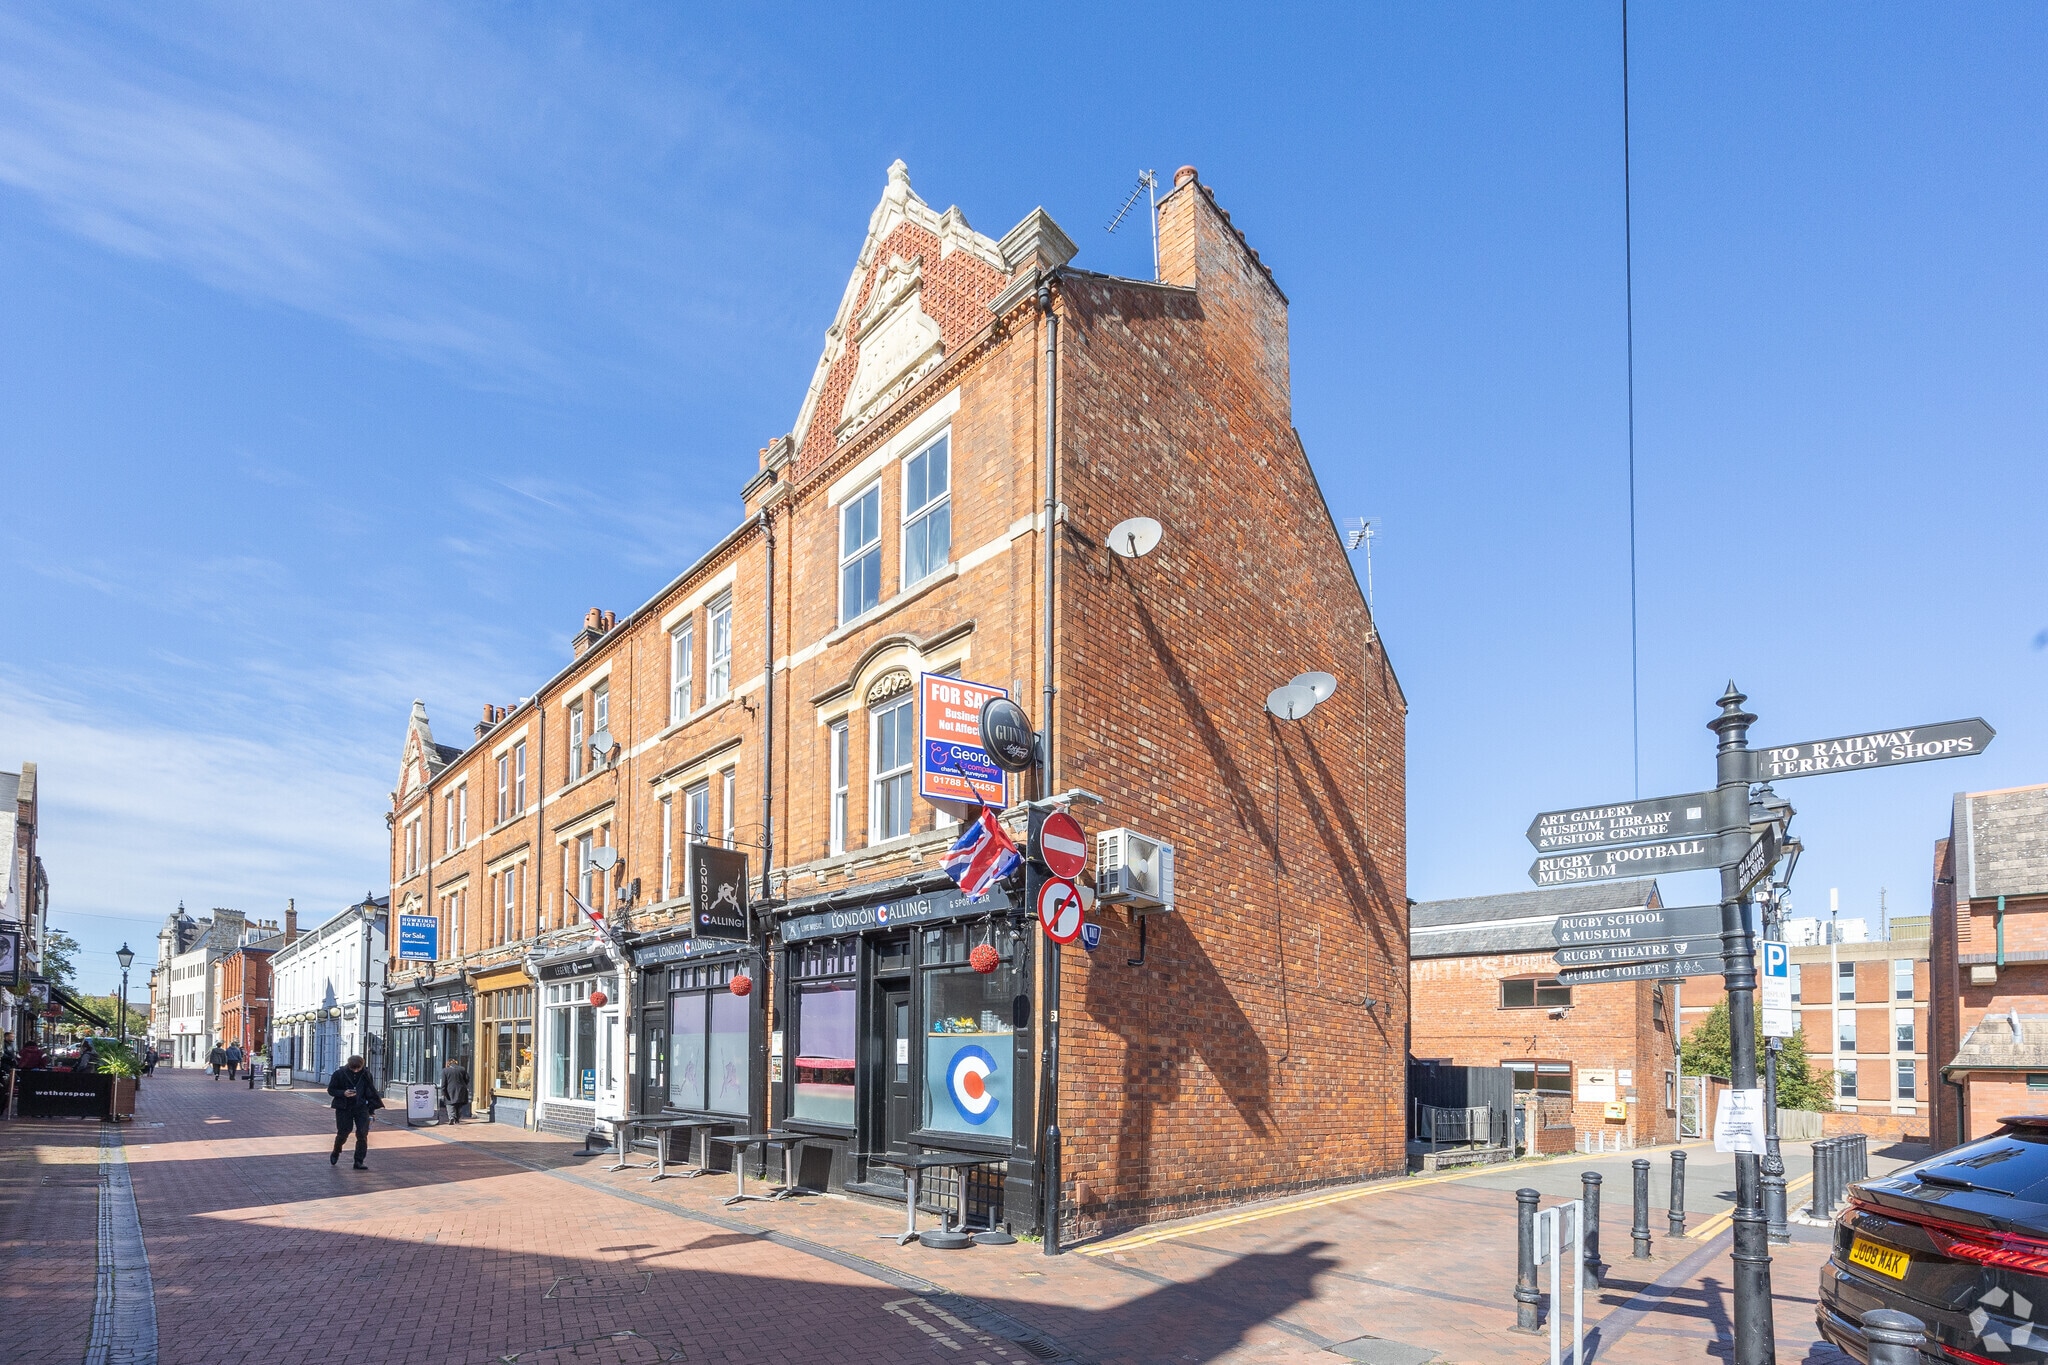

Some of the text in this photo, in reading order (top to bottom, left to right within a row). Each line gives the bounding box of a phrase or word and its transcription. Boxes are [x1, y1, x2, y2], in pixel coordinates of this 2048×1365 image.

[931, 683, 960, 705] FOR
[945, 708, 980, 723] Busines
[939, 719, 980, 736] Not Affect
[1769, 730, 1915, 763] TO RAILWAY
[1769, 737, 1973, 776] TERRACE SHOPS
[941, 766, 966, 776] chartere
[968, 764, 998, 776] company
[933, 776, 961, 787] 01788
[1539, 812, 1672, 836] MUSEUM, LIBRARY
[1540, 806, 1634, 826] ART GALLERY
[1539, 824, 1668, 847] &VISITOR CENTRE
[1539, 841, 1705, 871] RUGBY FOOTBALL
[1538, 864, 1616, 884] MUSEUM
[701, 914, 745, 928] CALLING!
[831, 909, 875, 929] LONDON
[877, 900, 932, 925] CALLING!
[1562, 913, 1664, 929] RUGBY SCHOOL
[1562, 928, 1631, 942] & MUSEUM
[658, 944, 684, 957] LONDON
[1563, 945, 1669, 962] RUGBY THEATRE
[1566, 963, 1669, 981] PUBLIC TOILETS
[1878, 1250, 1903, 1274] MAK
